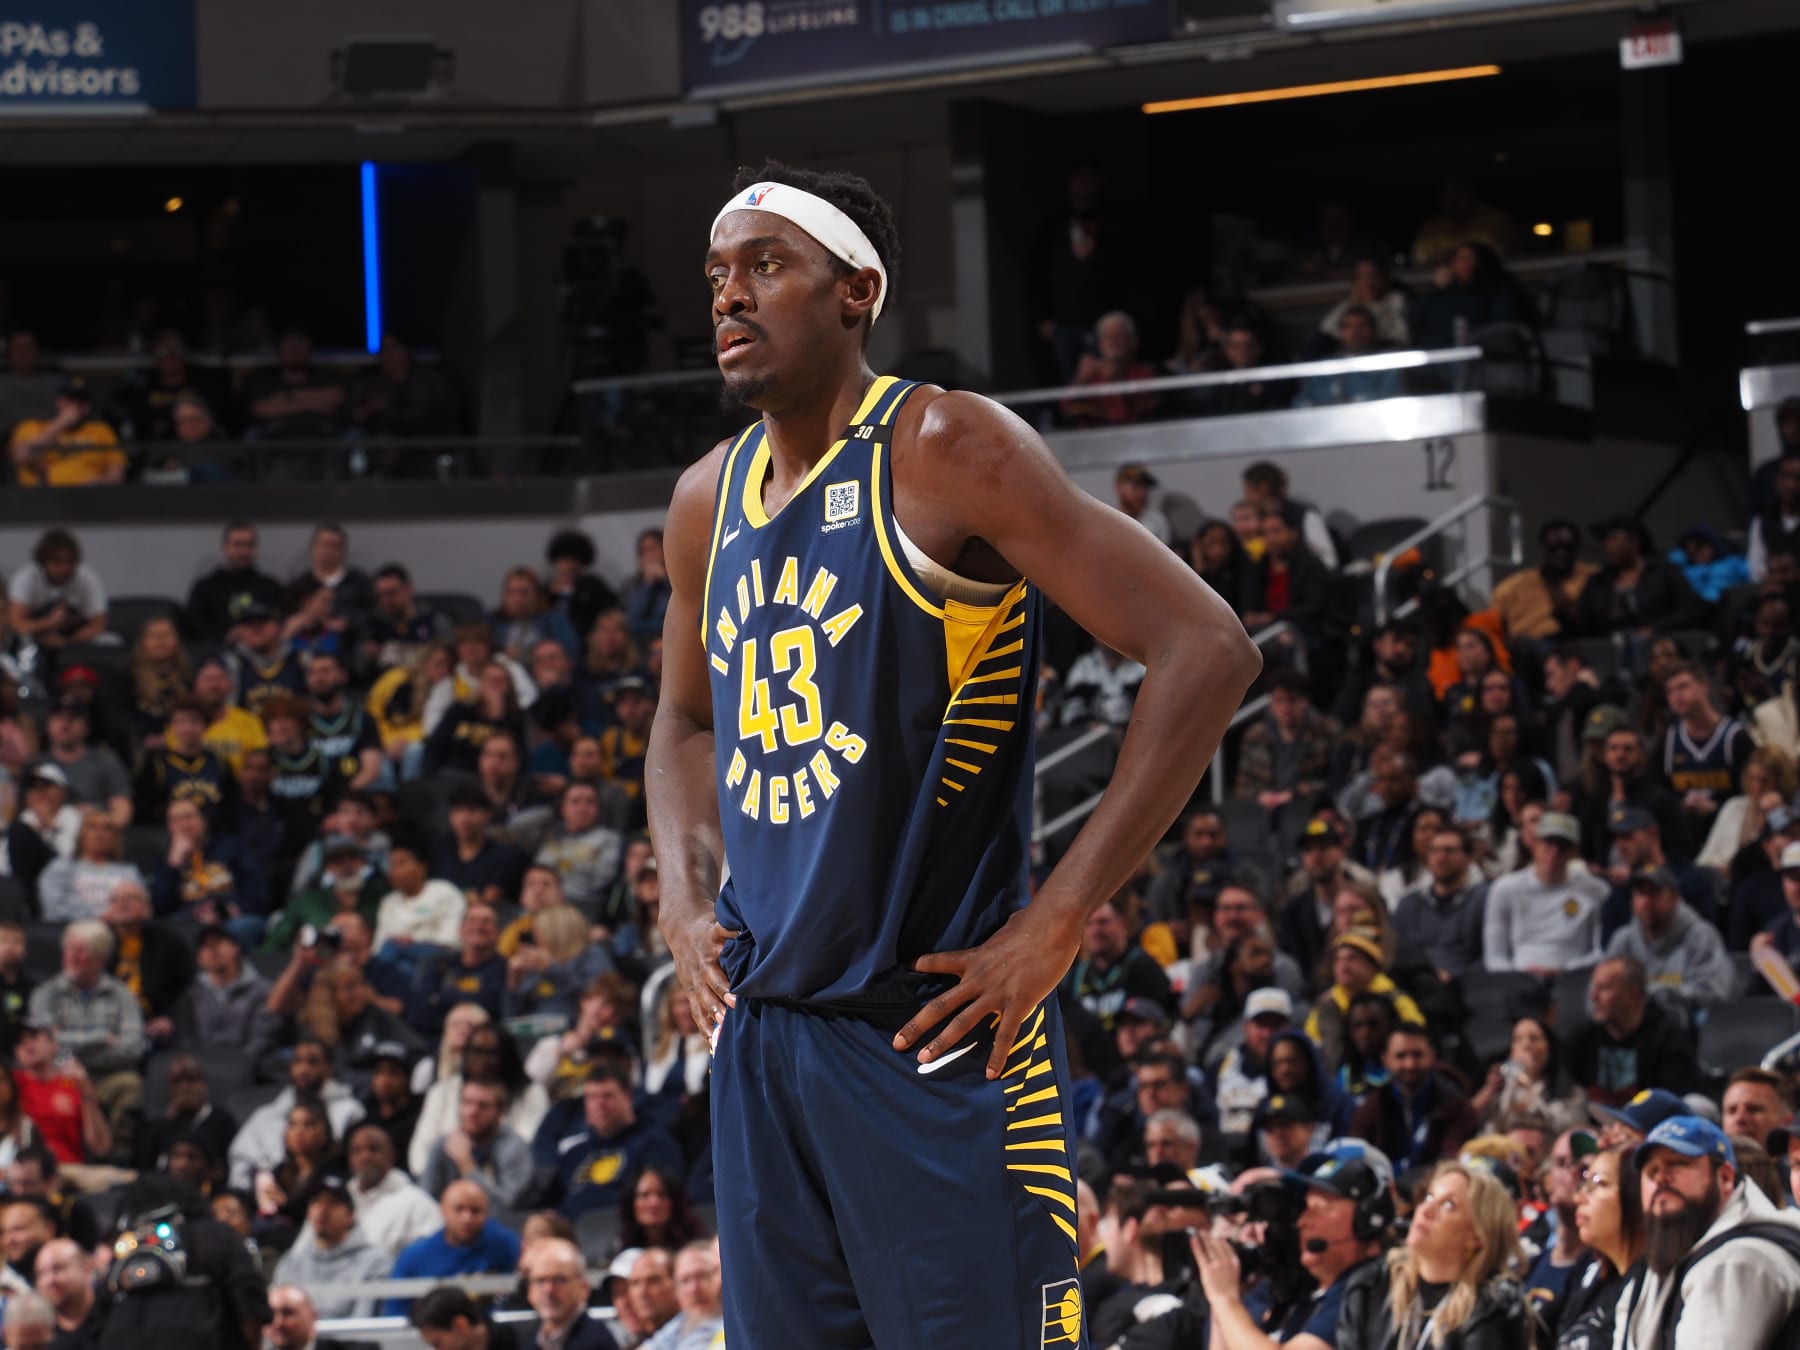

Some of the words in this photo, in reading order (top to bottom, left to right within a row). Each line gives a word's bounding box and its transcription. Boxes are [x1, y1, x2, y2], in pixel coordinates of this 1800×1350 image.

[0, 22, 70, 56] PAs
[73, 22, 103, 56] &
[699, 0, 765, 42] 988
[767, 6, 858, 34] LIFELINE
[0, 60, 140, 95] dvisors
[854, 425, 874, 440] 30
[1424, 434, 1457, 492] 12
[821, 517, 861, 533] spokenote
[711, 556, 863, 676] INDIANA
[738, 624, 823, 754] 43
[725, 720, 867, 824] PACERS
